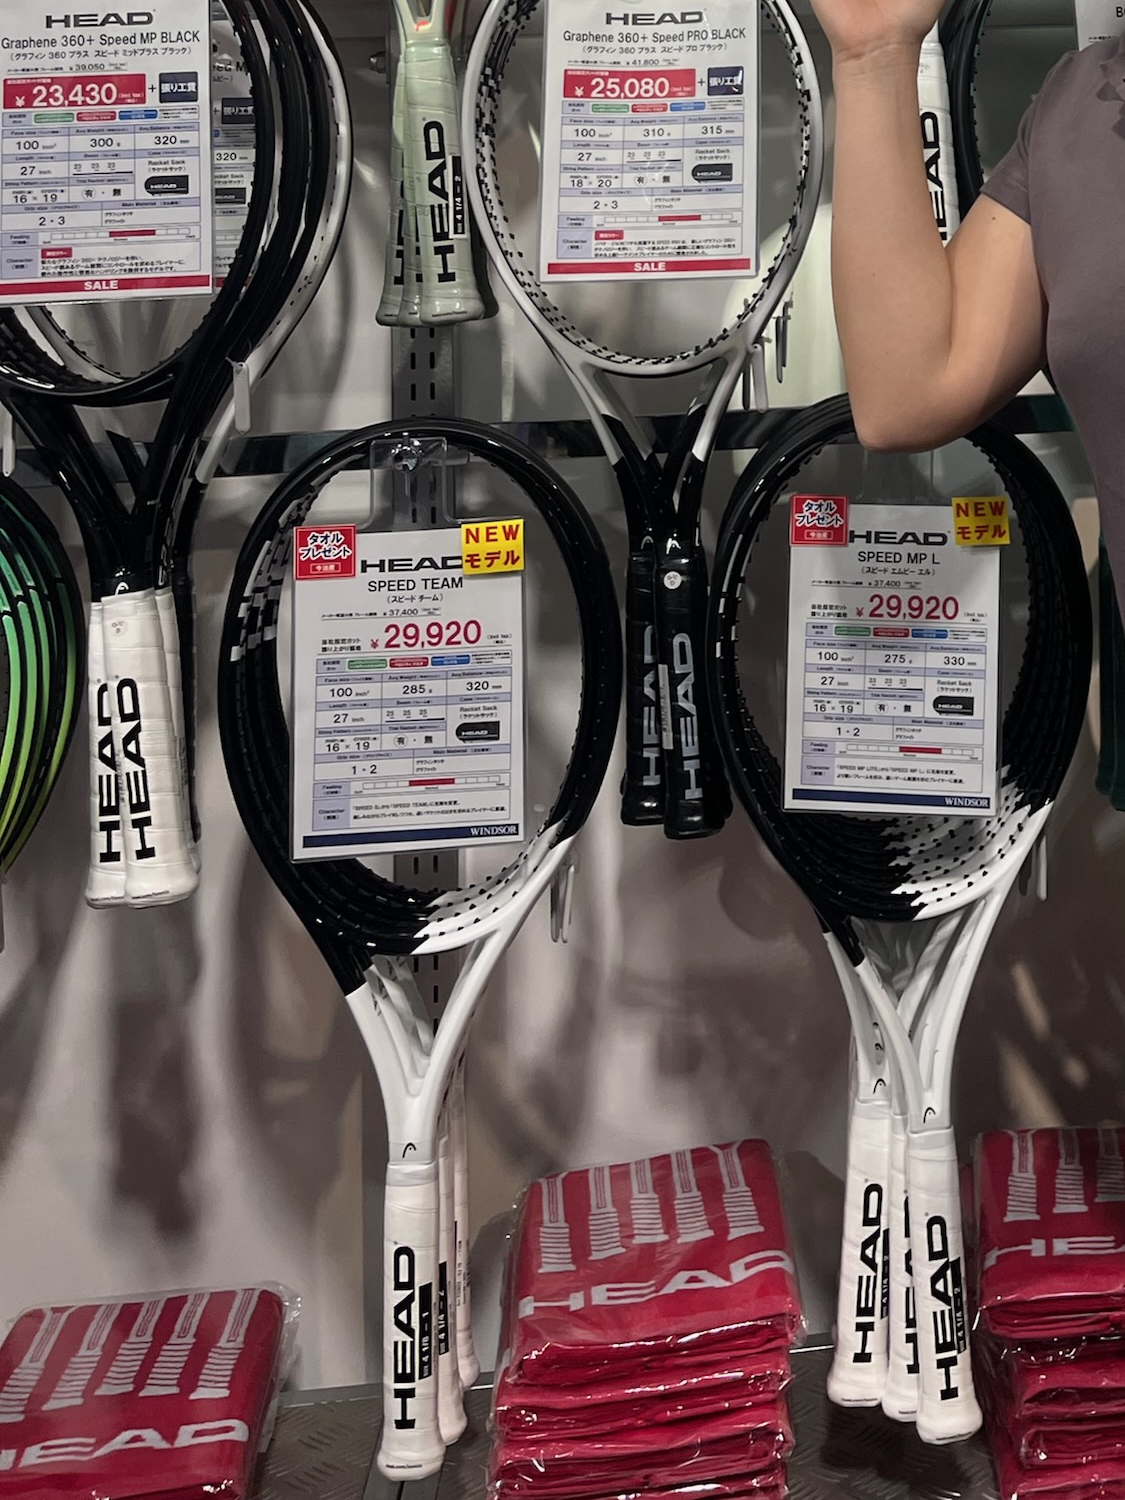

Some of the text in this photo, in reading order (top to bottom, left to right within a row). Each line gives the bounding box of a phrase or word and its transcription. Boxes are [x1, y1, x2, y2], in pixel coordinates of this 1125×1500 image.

[46, 12, 153, 28] HEAD
[606, 11, 703, 25] HEAD
[1, 31, 200, 51] Graphene 360+ Speed MP BLACK
[563, 28, 746, 44] Graphene 360+ Speed PRO BLACK
[161, 83, 197, 93] 張り工賃
[591, 78, 669, 99] 25,080
[710, 76, 742, 87] 張り工賃
[32, 83, 117, 107] 23,430
[921, 112, 947, 240] EAD
[423, 120, 456, 283] HEAD
[634, 262, 666, 272] SALE
[84, 280, 118, 290] SALE
[803, 502, 836, 513] タオル
[956, 501, 1005, 517] NEW
[796, 514, 844, 526] プレゼント
[309, 533, 342, 545] タオル
[465, 525, 519, 543] NEW
[849, 531, 948, 545] HEAD
[957, 525, 1006, 540] モデル
[301, 546, 351, 560] プレゼント
[465, 551, 520, 569] モデル
[858, 552, 940, 564] SPEED MP L
[361, 556, 462, 573] HEAD
[368, 578, 463, 593] SPEED TEAM
[869, 594, 959, 621] 29,920
[384, 620, 481, 649] 29,920
[673, 633, 703, 799] HEAD
[97, 683, 121, 863] HEAD
[116, 678, 156, 860] HEAD
[944, 798, 988, 807] WINDSOR
[470, 825, 517, 835] WINDSOR
[852, 1184, 883, 1363] HEAD
[519, 1250, 795, 1319] HEAD
[926, 1215, 958, 1401] HEAD
[394, 1246, 415, 1429] HEAD
